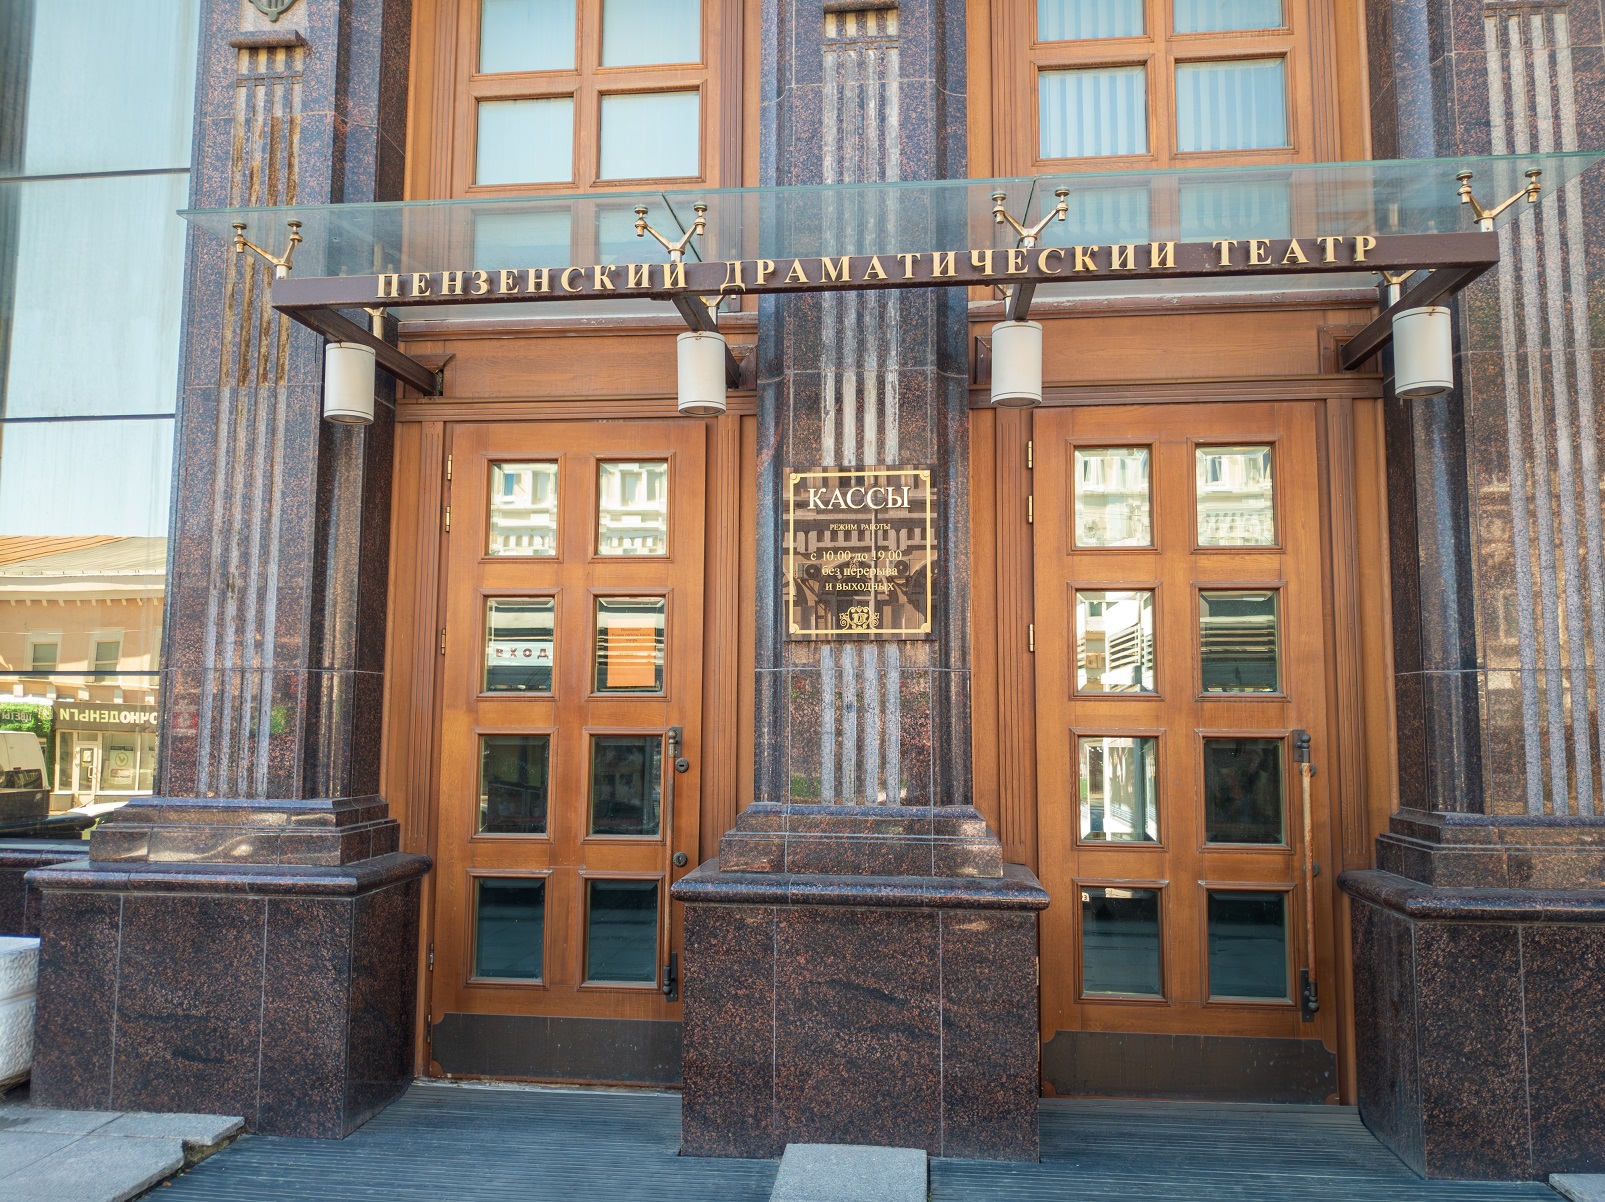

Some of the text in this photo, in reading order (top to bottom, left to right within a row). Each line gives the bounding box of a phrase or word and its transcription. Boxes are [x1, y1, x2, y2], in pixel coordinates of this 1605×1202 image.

[1212, 235, 1377, 266] ТЕАТР
[807, 486, 911, 510] КАССЫ
[829, 523, 891, 531] РЕЖИМ РАБОТЫ
[822, 550, 851, 561] 10.00
[853, 552, 868, 562] до
[872, 550, 902, 561] 19.00
[821, 565, 898, 578] без перерыва
[825, 582, 895, 592] и выходных
[495, 647, 549, 660] ВХОД
